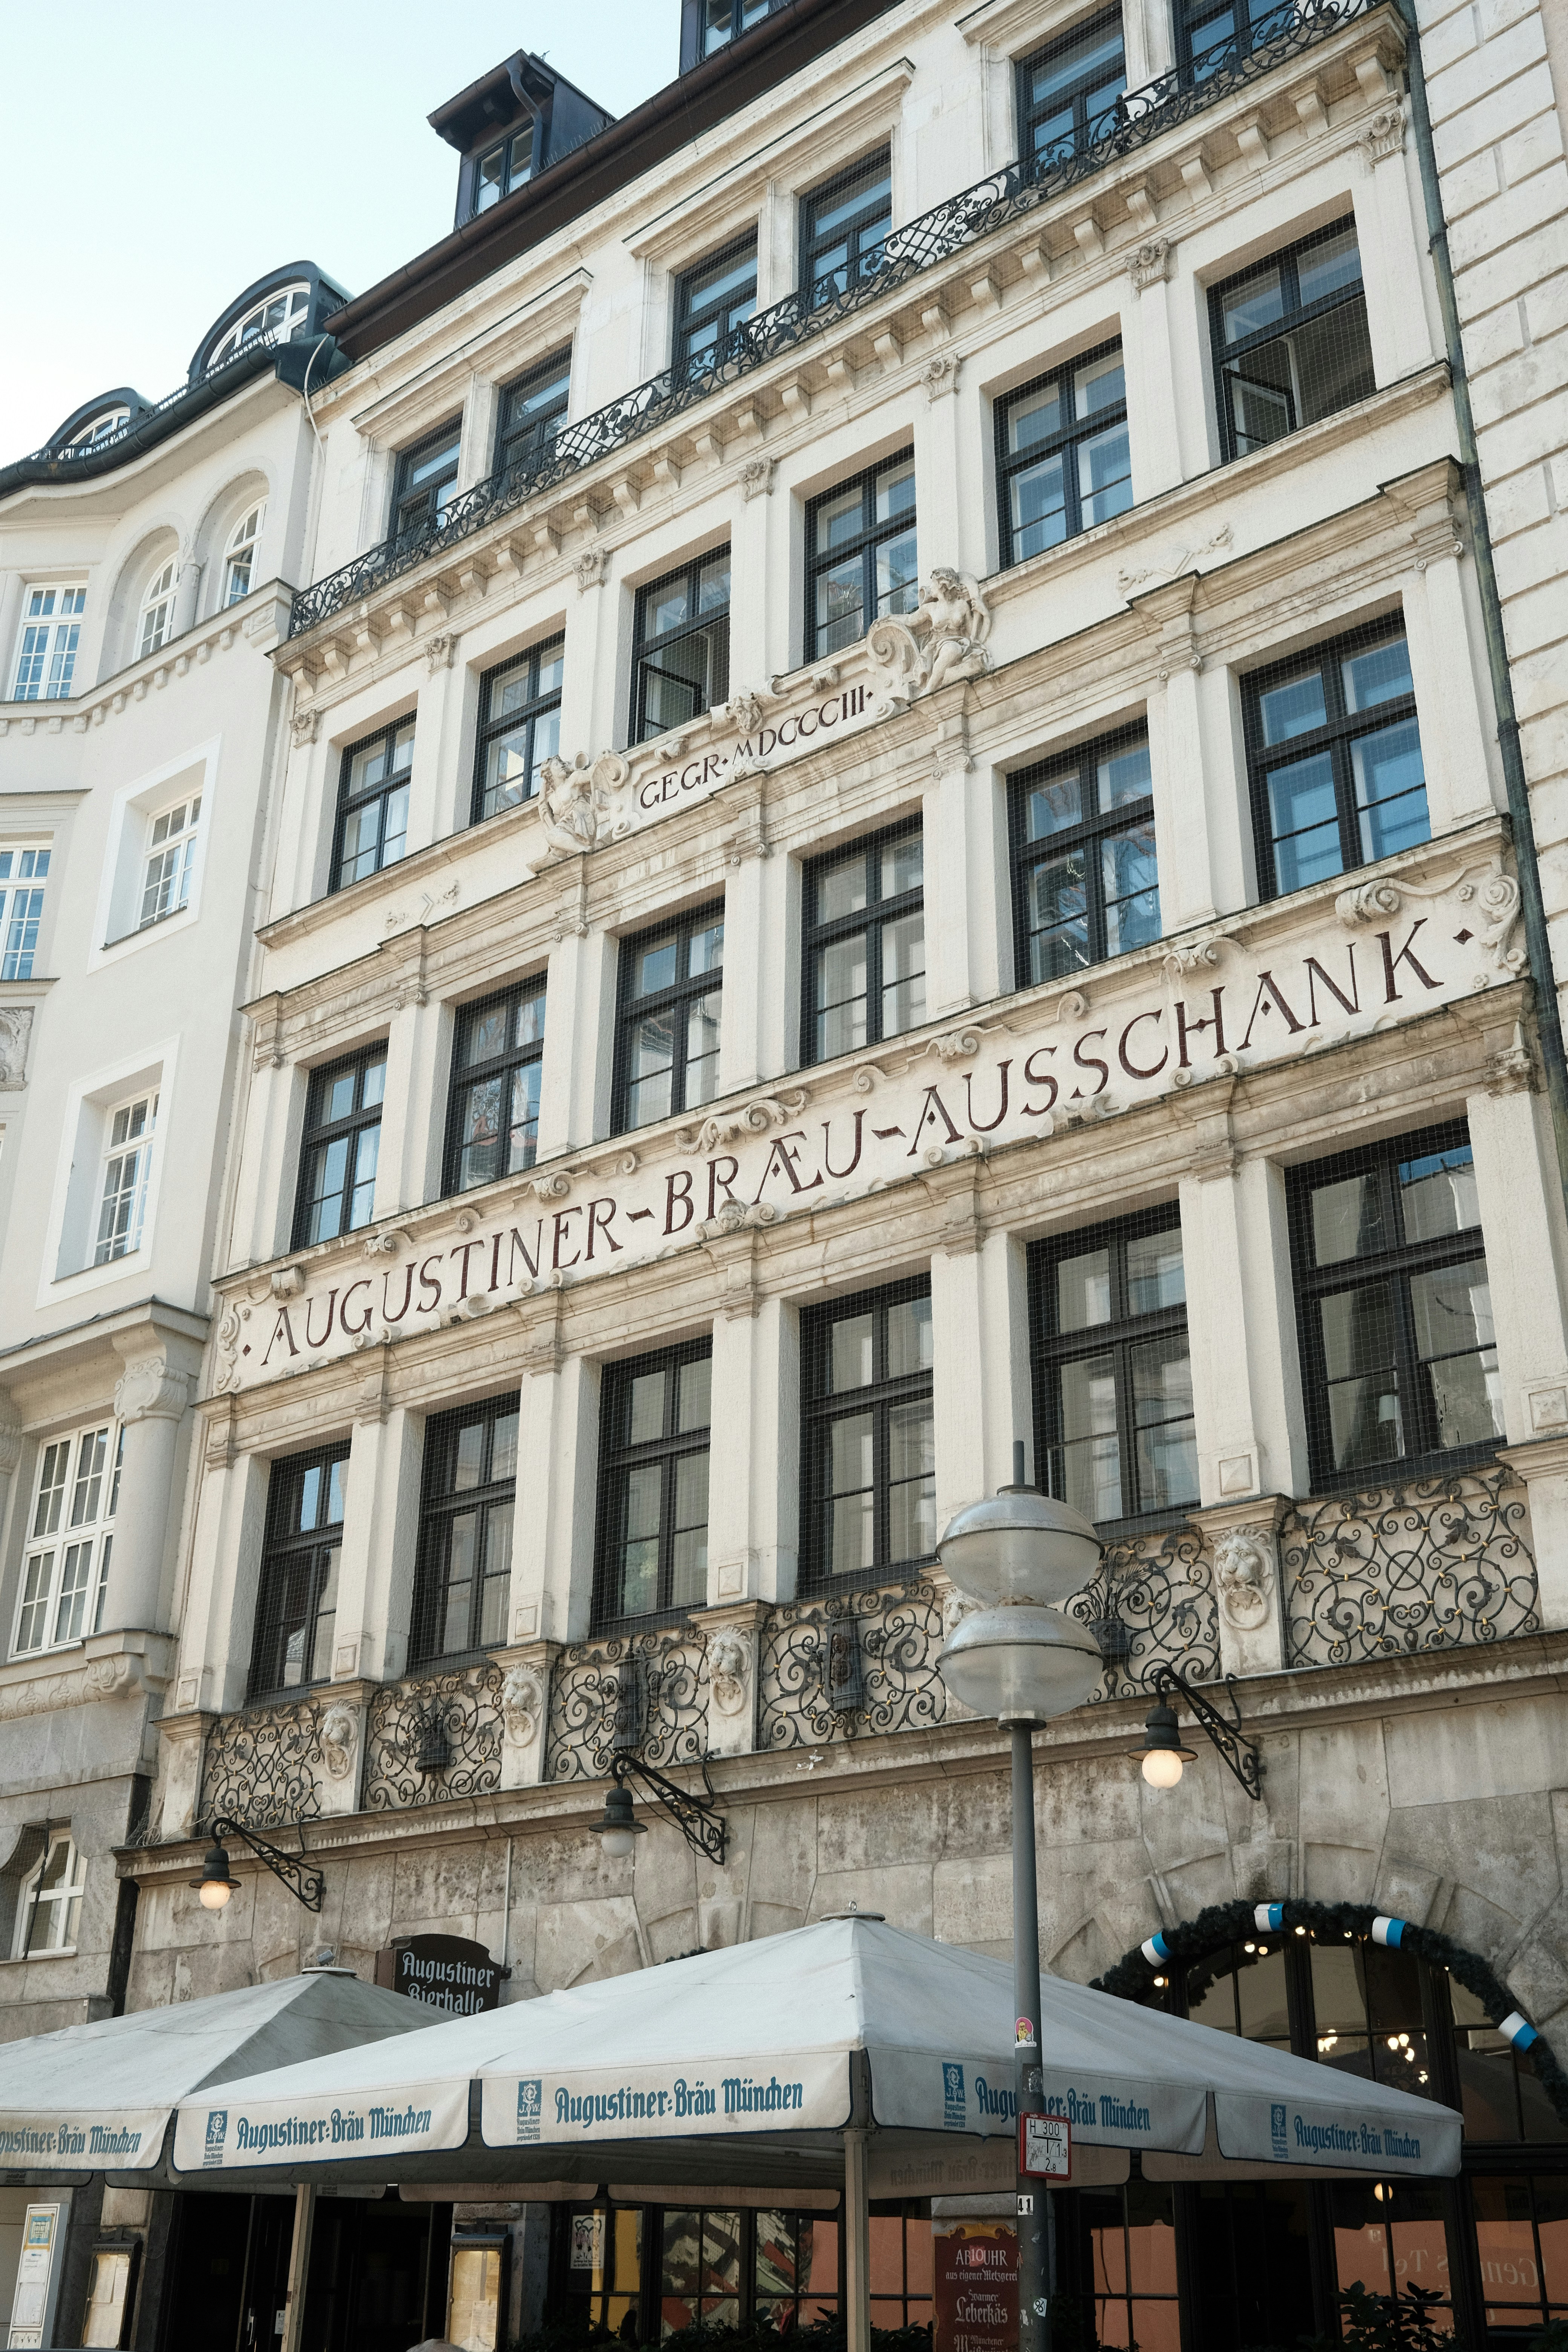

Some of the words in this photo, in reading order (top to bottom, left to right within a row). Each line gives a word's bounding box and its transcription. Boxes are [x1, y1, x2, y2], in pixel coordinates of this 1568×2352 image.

[402, 1951, 495, 1988] Augustiner
[721, 2076, 802, 2114] München
[368, 2104, 432, 2139] München
[1030, 2119, 1036, 2133] H
[1043, 2121, 1059, 2136] 300
[1099, 2095, 1151, 2131] München
[89, 2125, 142, 2154] München
[1384, 2129, 1421, 2159] München
[983, 2250, 1008, 2266] UHR
[946, 2272, 957, 2280] aus
[959, 2269, 982, 2282] eigener
[982, 2268, 1017, 2282] Metzgerei
[954, 2296, 1008, 2326] Leberkäs
